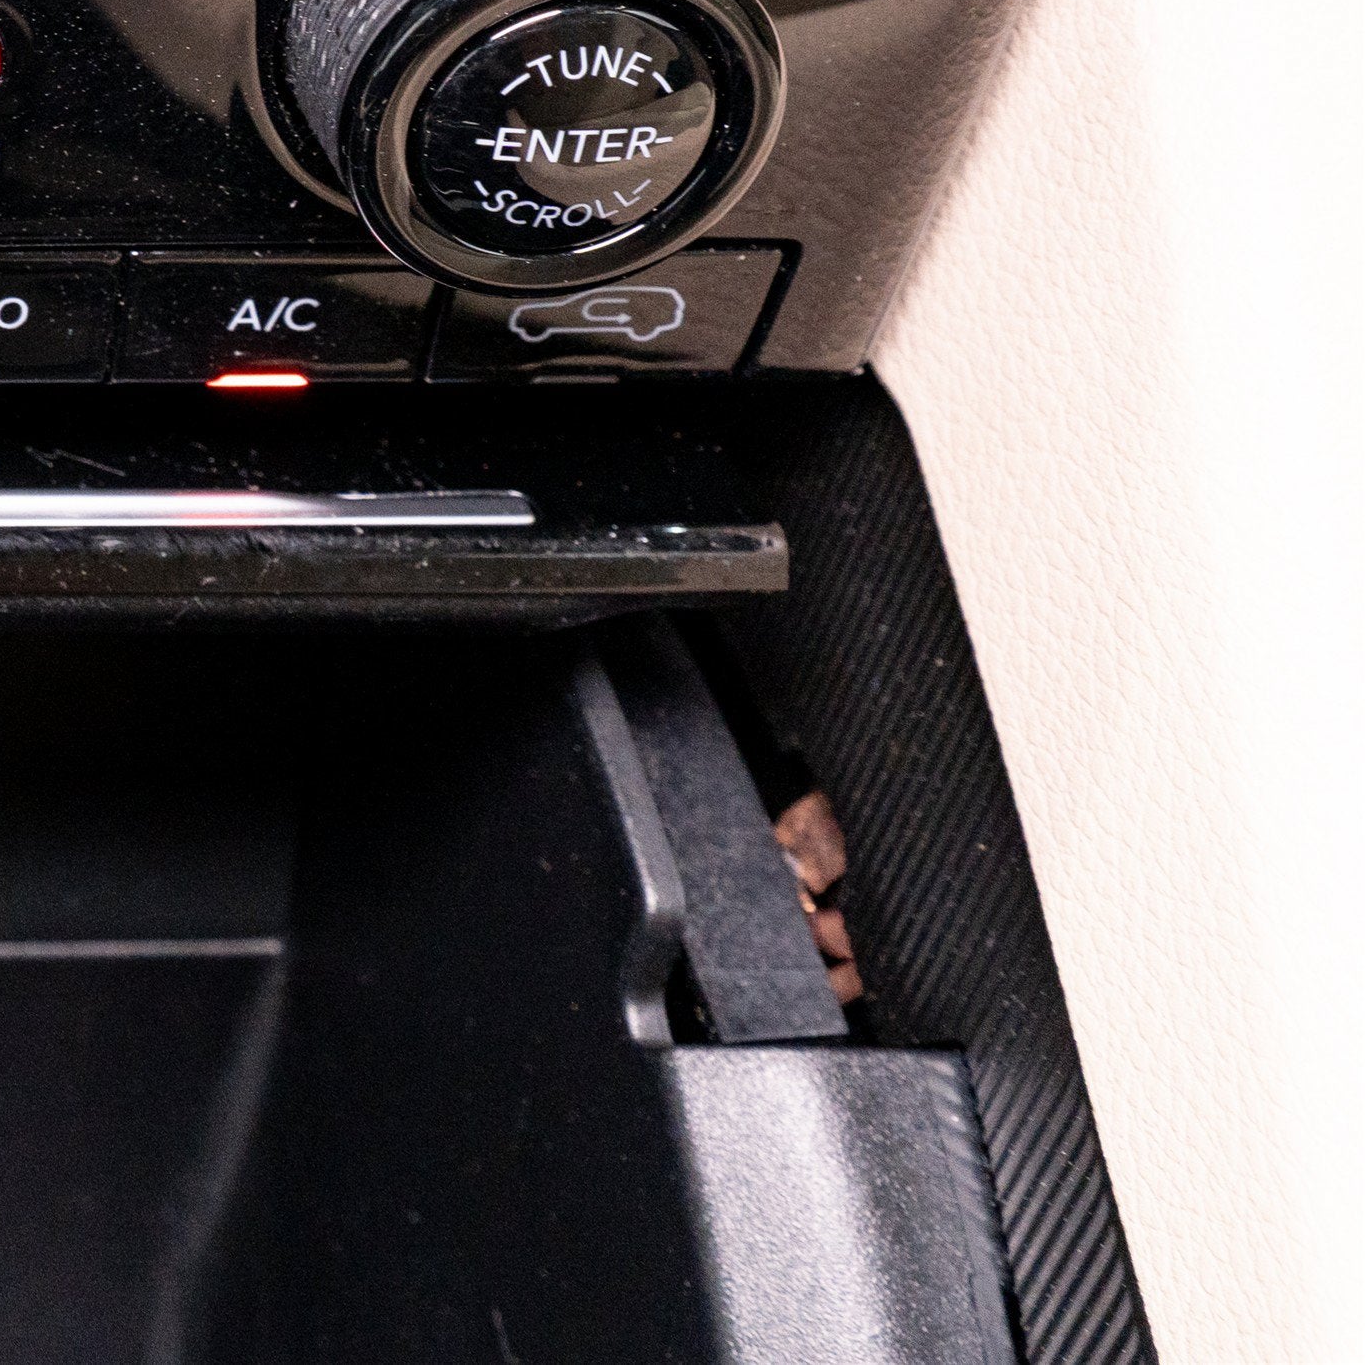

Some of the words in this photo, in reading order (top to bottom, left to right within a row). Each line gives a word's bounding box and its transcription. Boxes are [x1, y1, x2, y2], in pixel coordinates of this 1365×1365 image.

[526, 45, 651, 88] TUNE
[492, 127, 656, 163] ENTER
[481, 188, 639, 230] SCROLL
[227, 297, 319, 332] A/C
